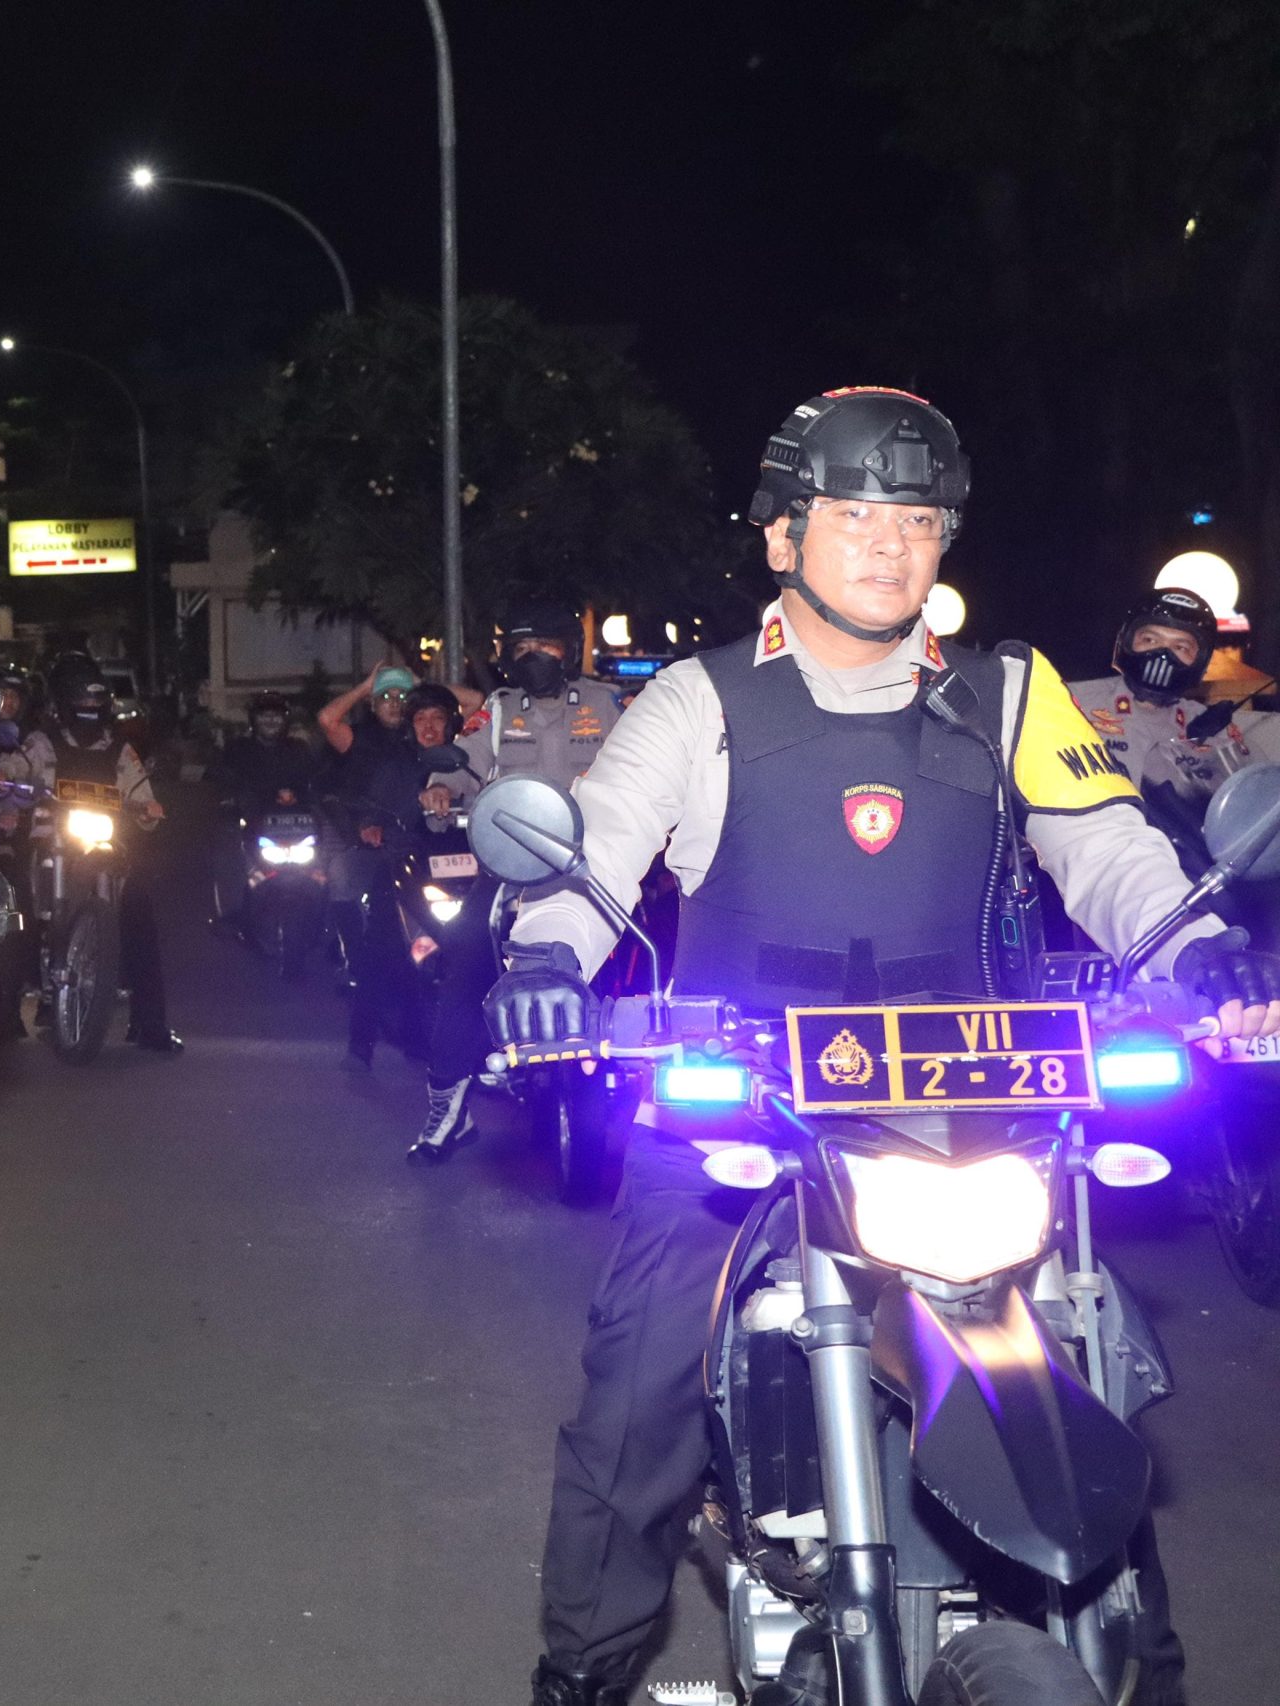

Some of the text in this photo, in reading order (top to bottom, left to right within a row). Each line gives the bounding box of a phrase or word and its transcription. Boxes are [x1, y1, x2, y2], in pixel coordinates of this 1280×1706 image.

[48, 522, 90, 534] LOBBY
[12, 537, 132, 552] PELAYANAN MASYARAKAT
[844, 784, 903, 799] KORPS SABHARA
[956, 1012, 1013, 1051] VII
[920, 1060, 946, 1097] 2
[1009, 1057, 1068, 1096] 28
